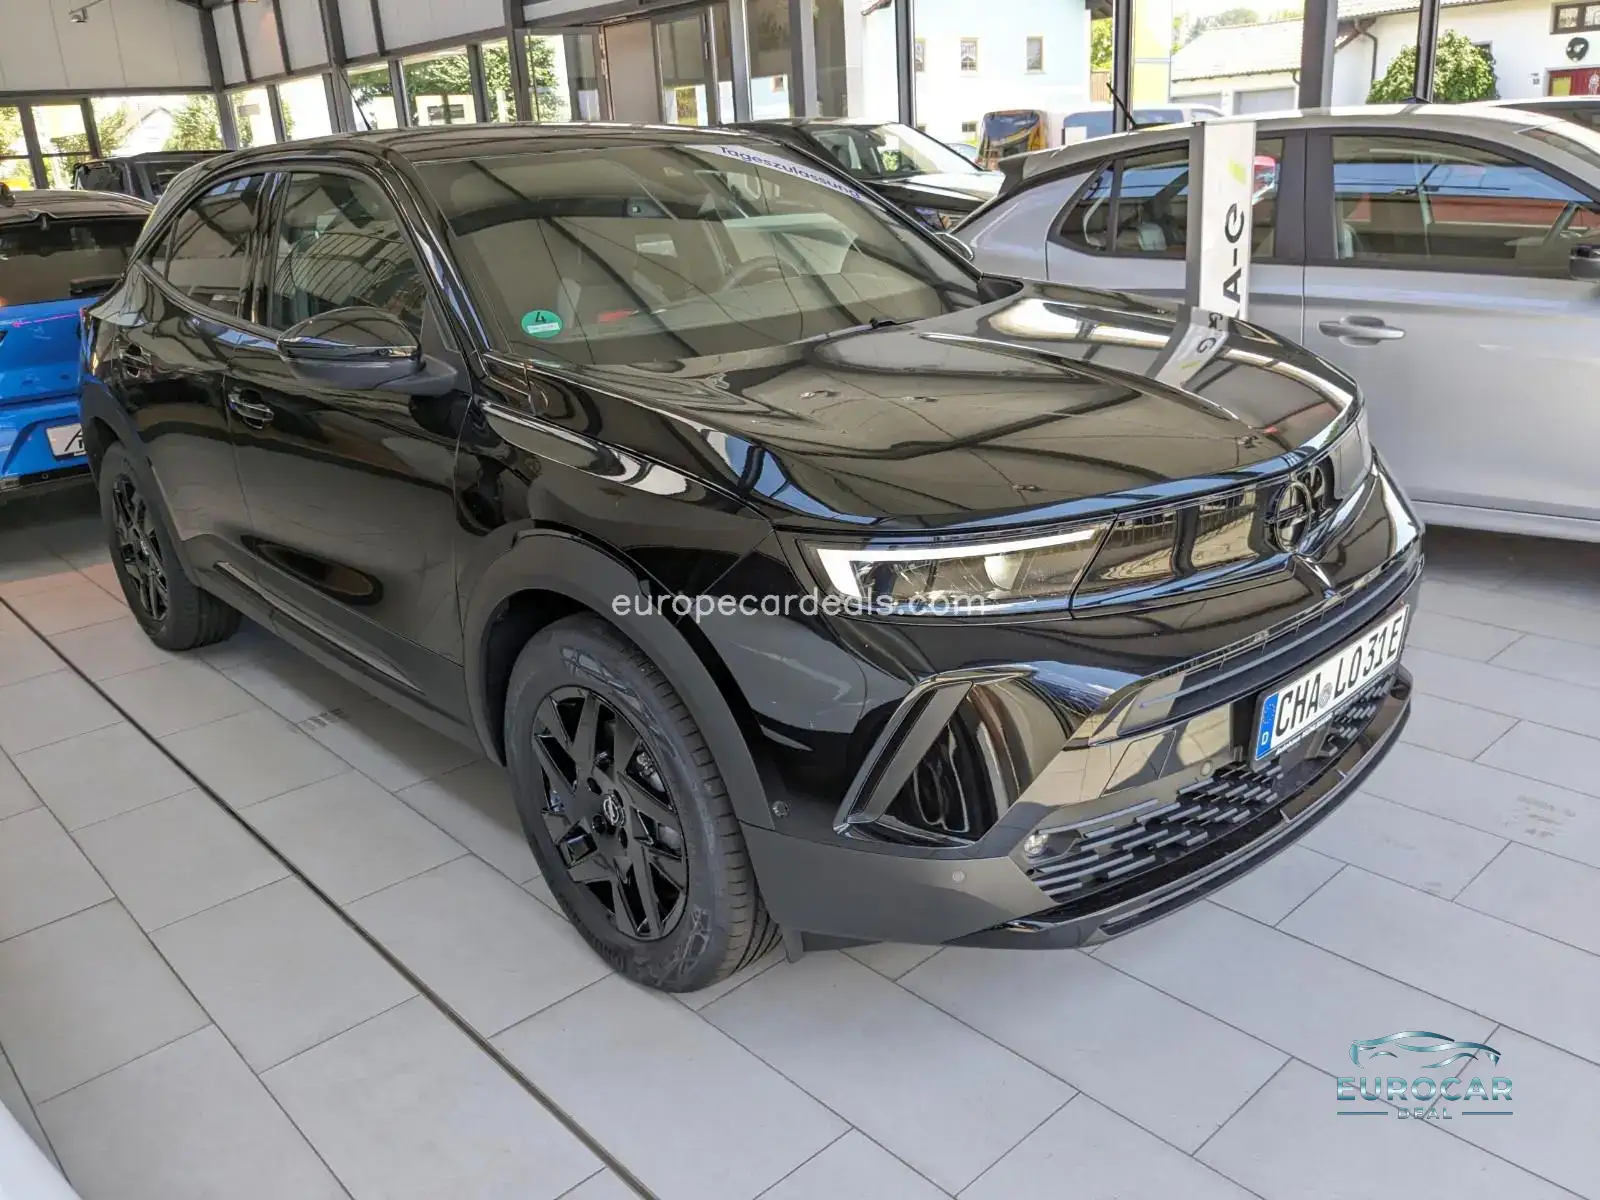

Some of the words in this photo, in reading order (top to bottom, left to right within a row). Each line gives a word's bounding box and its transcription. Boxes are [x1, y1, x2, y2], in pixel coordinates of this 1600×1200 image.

[1223, 203, 1245, 319] A-e
[535, 311, 547, 323] 4
[1275, 672, 1322, 737] CHA
[1261, 731, 1269, 746] D
